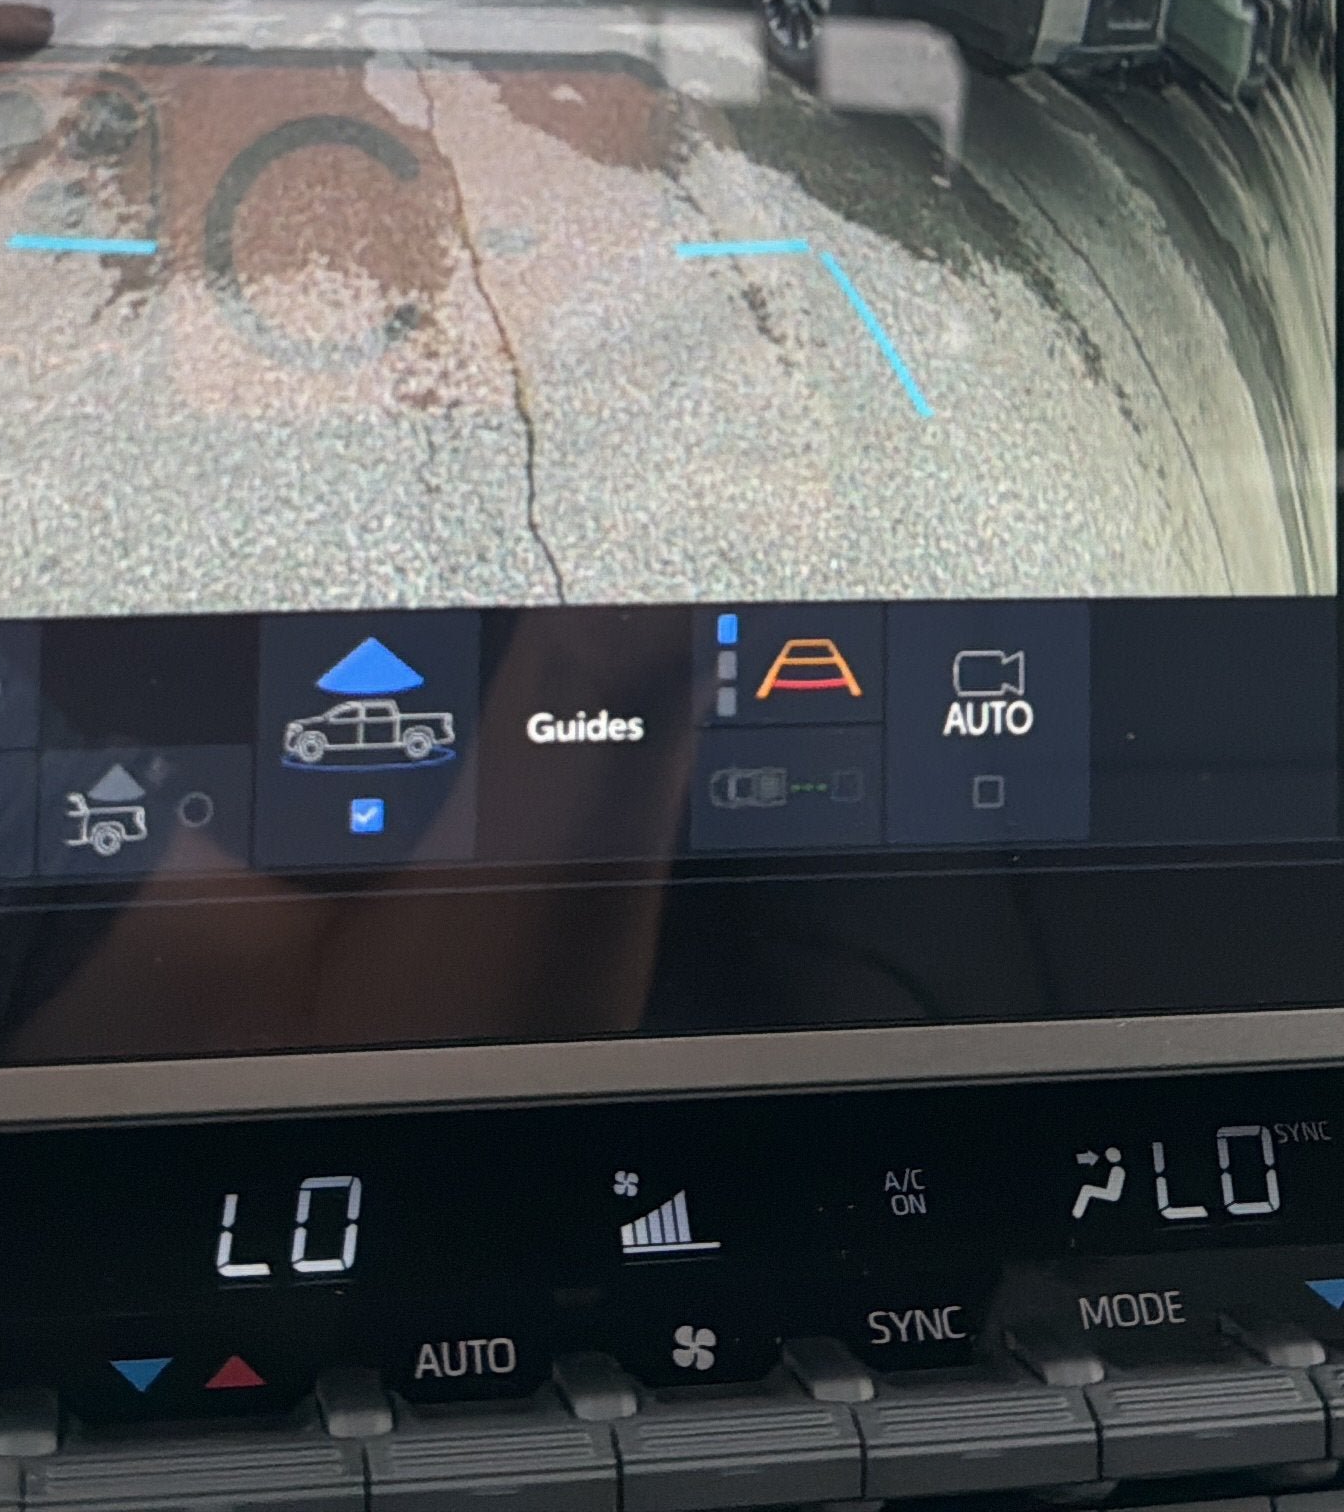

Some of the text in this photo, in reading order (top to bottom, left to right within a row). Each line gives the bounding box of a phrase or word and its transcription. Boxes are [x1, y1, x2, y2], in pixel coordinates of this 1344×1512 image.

[526, 710, 646, 744] Guides
[943, 699, 1035, 738] AUTO
[1272, 1120, 1333, 1146] SYNC
[884, 1168, 927, 1192] A/C
[891, 1193, 928, 1217] ON
[867, 1305, 967, 1345] SYNC
[1078, 1290, 1188, 1331] MODE
[414, 1336, 517, 1380] AUTO
